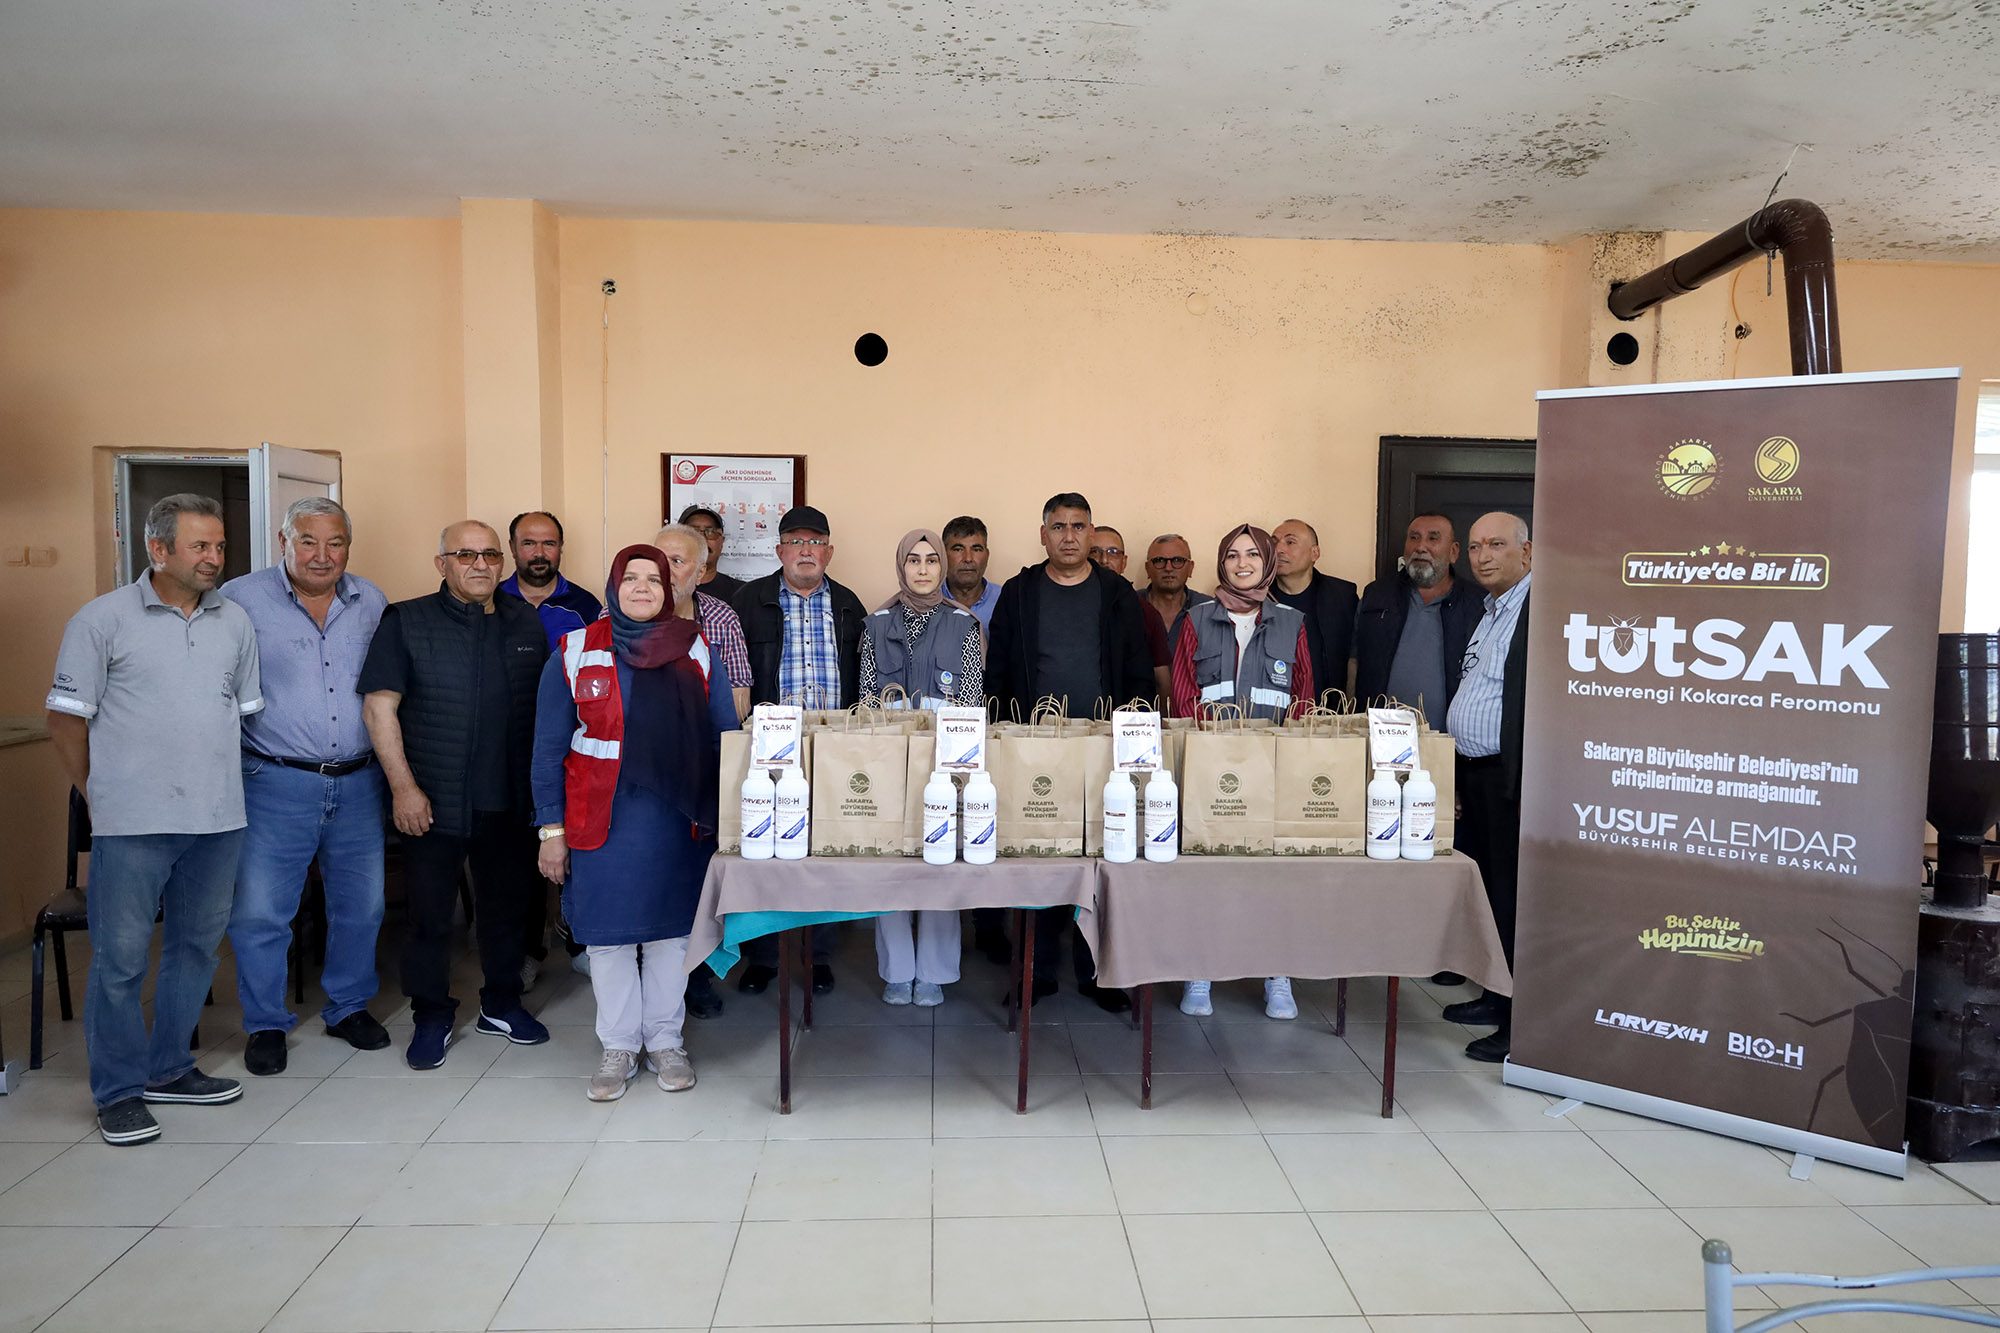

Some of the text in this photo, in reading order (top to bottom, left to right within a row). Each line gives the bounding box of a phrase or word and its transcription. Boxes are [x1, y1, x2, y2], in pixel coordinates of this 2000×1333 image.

[1668, 438, 1712, 450] SAKARYA
[1748, 486, 1802, 495] SAKARYA
[718, 502, 726, 514] 2
[738, 502, 746, 514] 3
[757, 502, 766, 515] 4
[778, 504, 786, 516] 5
[1628, 558, 1822, 584] Türkiye'de Bir İlk
[1564, 614, 1893, 690] tutSAK
[1568, 680, 1880, 716] Kahverengi Kokarca Feromonu
[1378, 728, 1408, 736] tutSAK
[1584, 741, 1858, 784] Sakarya Büyükşehir Belediyesi'nin
[1612, 768, 1822, 806] çiftçilerimize armağanıdır.
[778, 796, 800, 804] BIO-H
[966, 802, 989, 810] BIO-H
[1149, 800, 1172, 808] BIO-H
[1372, 798, 1395, 806] BIO-H
[1572, 803, 1856, 860] YUSUF ALEMDAR
[1578, 830, 1857, 875] BÜYÜKŞEHİR BELEDİYE BAŞKANI
[1665, 915, 1740, 932] Bu Şehir
[1638, 928, 1765, 956] Hepimizin
[1728, 1032, 1804, 1066] BIO-H
